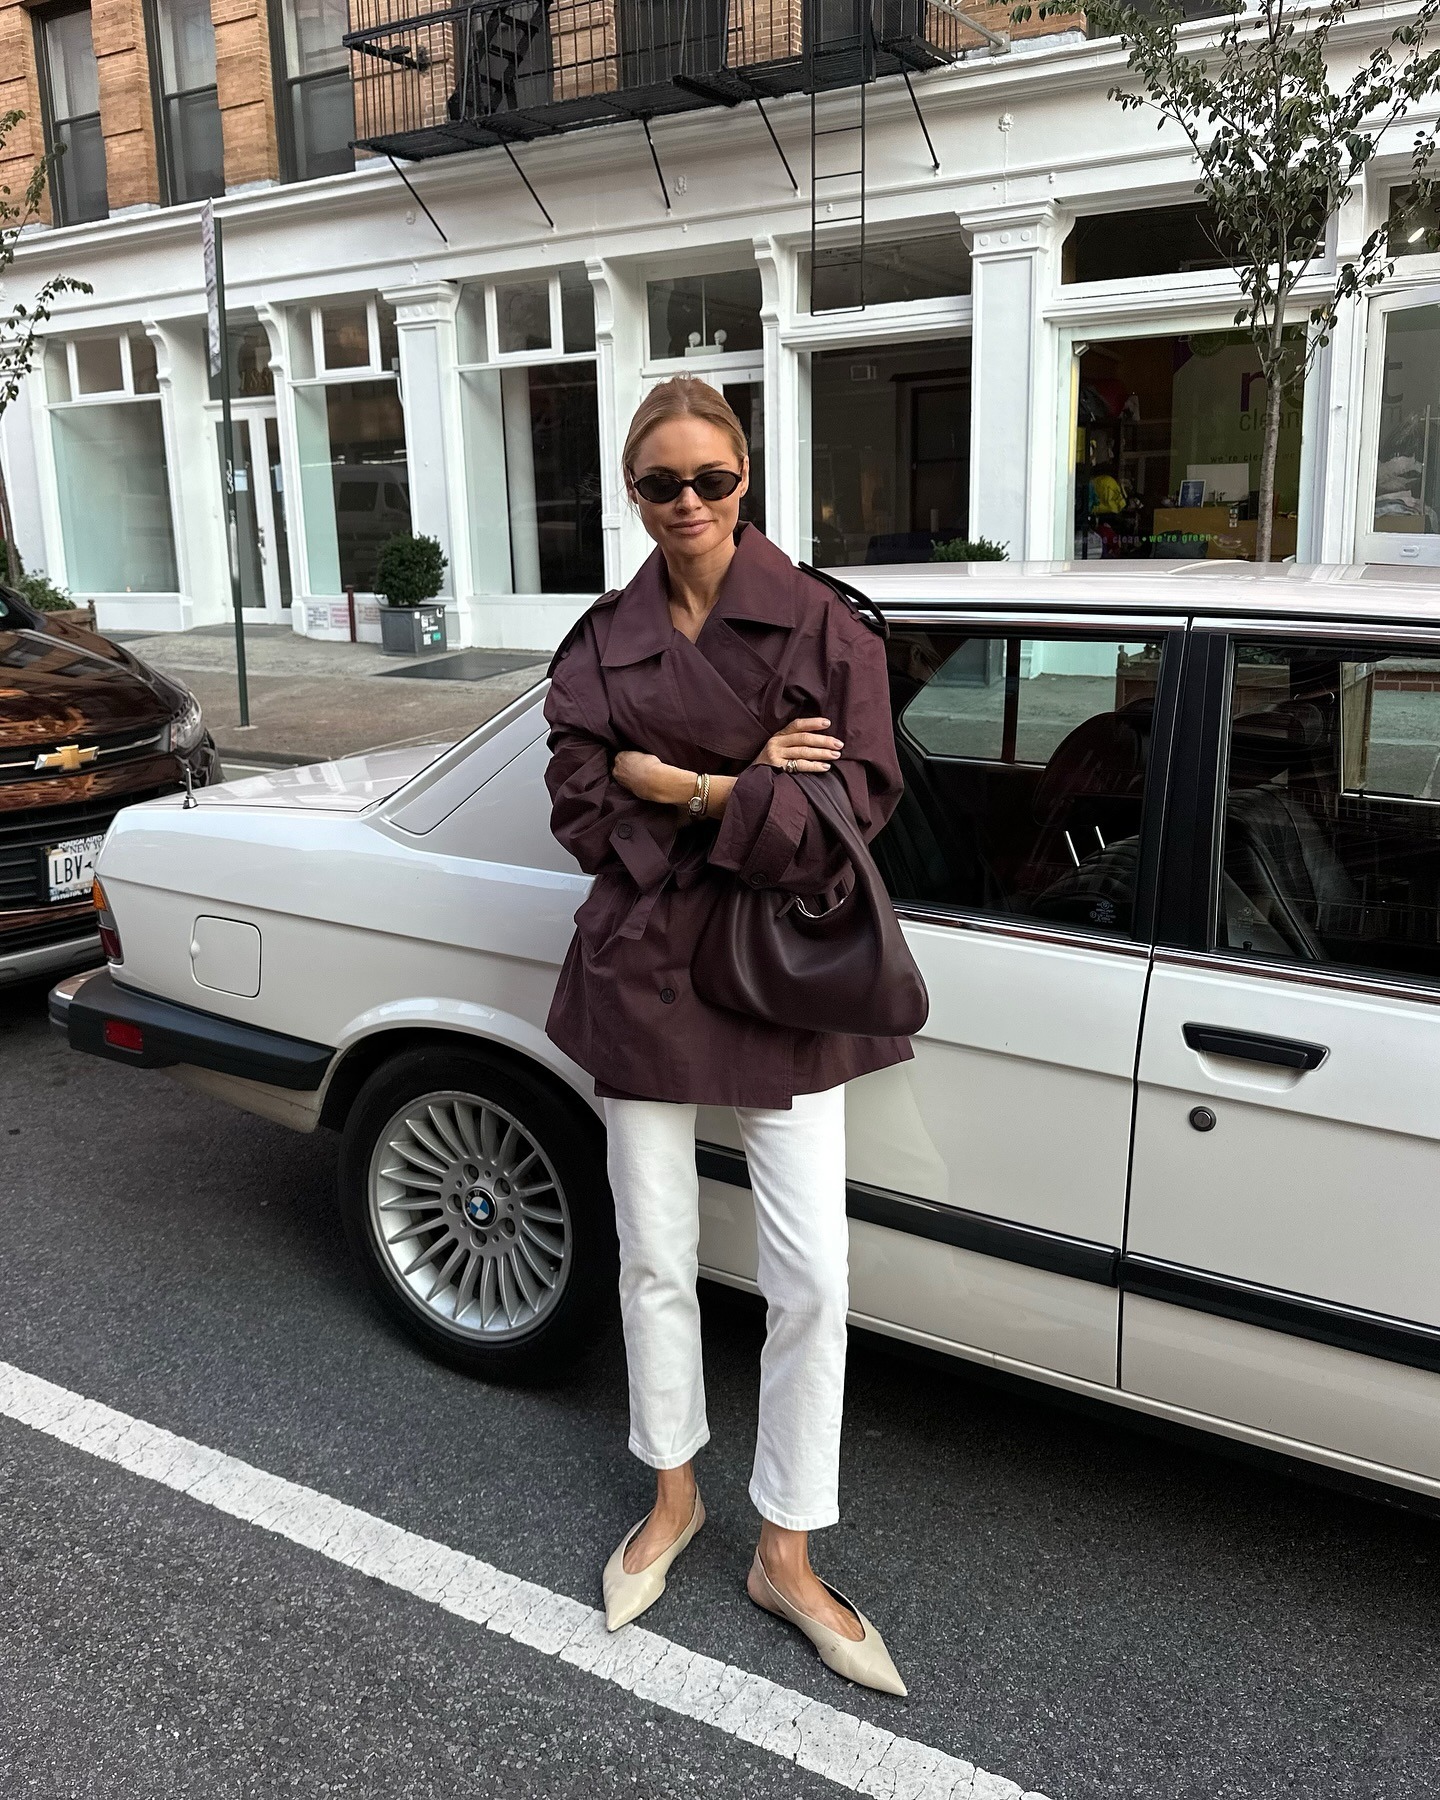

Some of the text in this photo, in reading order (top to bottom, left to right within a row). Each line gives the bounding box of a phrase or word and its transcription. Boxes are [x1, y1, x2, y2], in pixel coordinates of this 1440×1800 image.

[1149, 533, 1180, 544] we're
[1182, 532, 1212, 545] green
[69, 842, 91, 854] NEW
[54, 855, 83, 885] LBV
